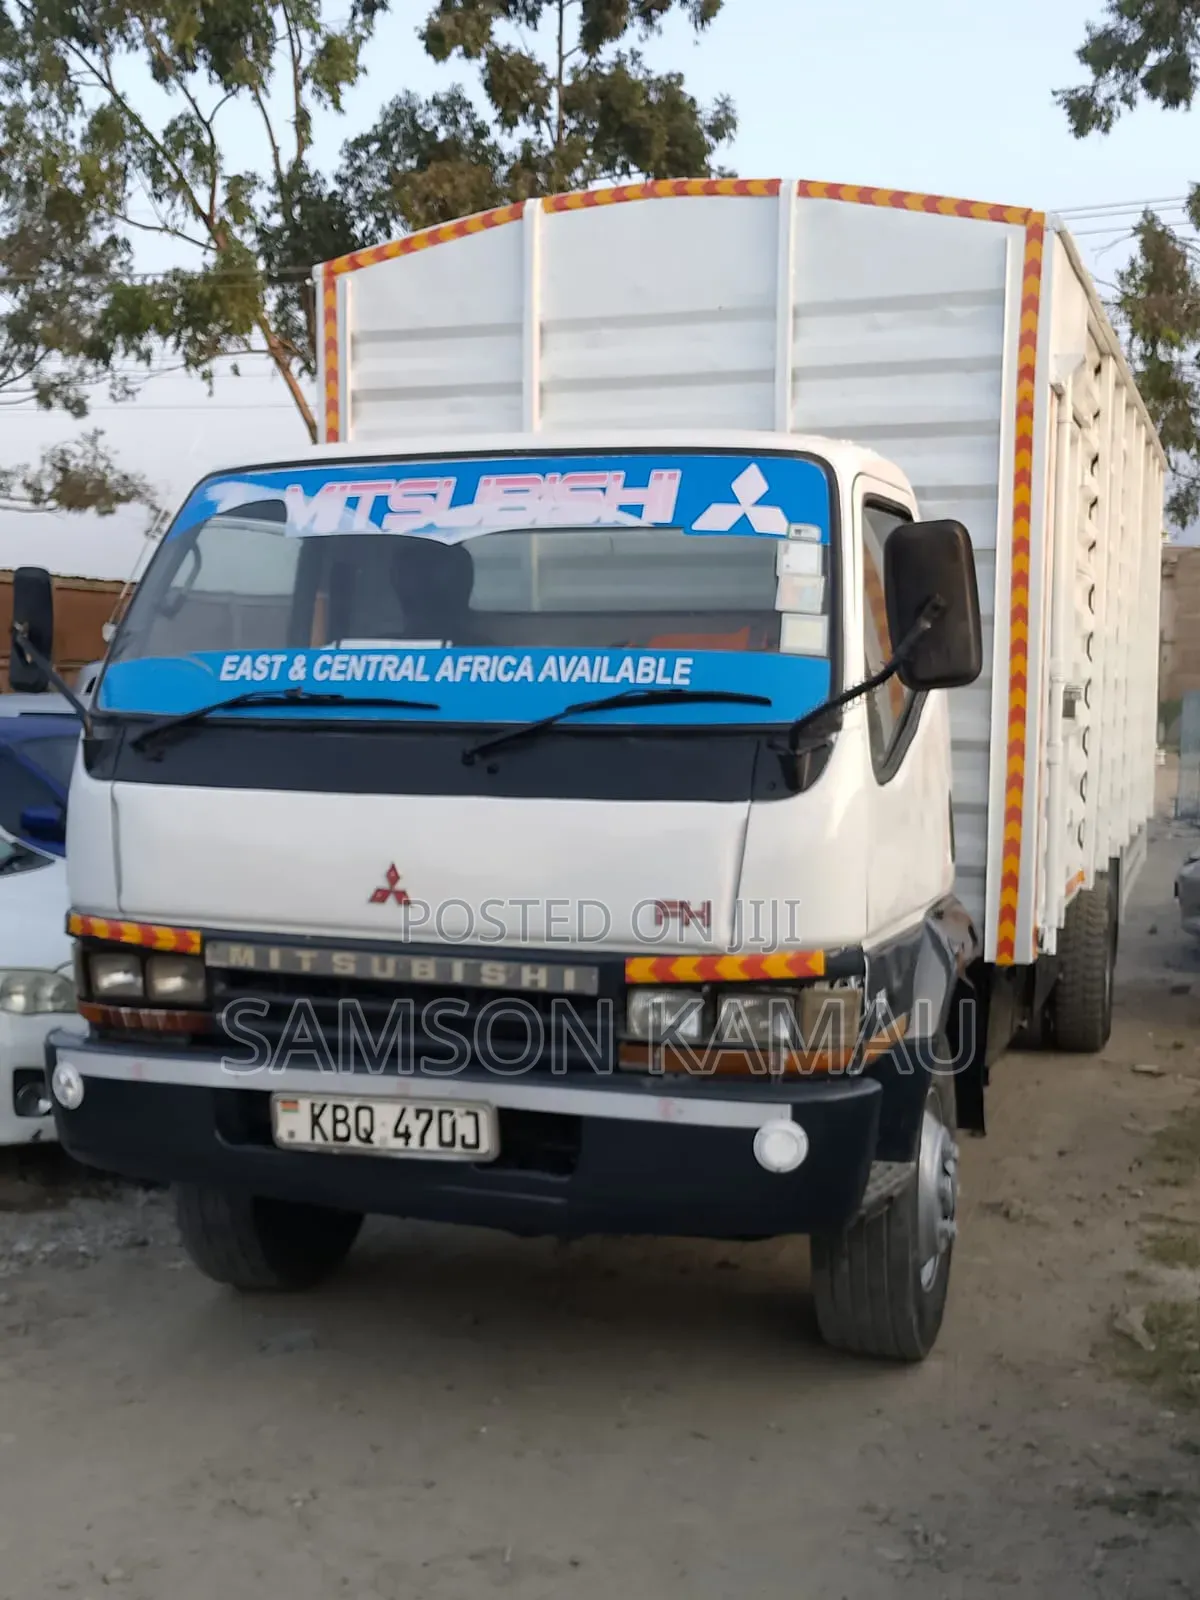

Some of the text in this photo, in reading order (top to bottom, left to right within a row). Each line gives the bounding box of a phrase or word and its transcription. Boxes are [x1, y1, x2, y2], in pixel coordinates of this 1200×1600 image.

[219, 654, 693, 685] EAST & CENTRAL AFRICA AVAILABLE
[229, 946, 576, 991] MITSUBISHI
[310, 1102, 480, 1149] KBQ 470J
